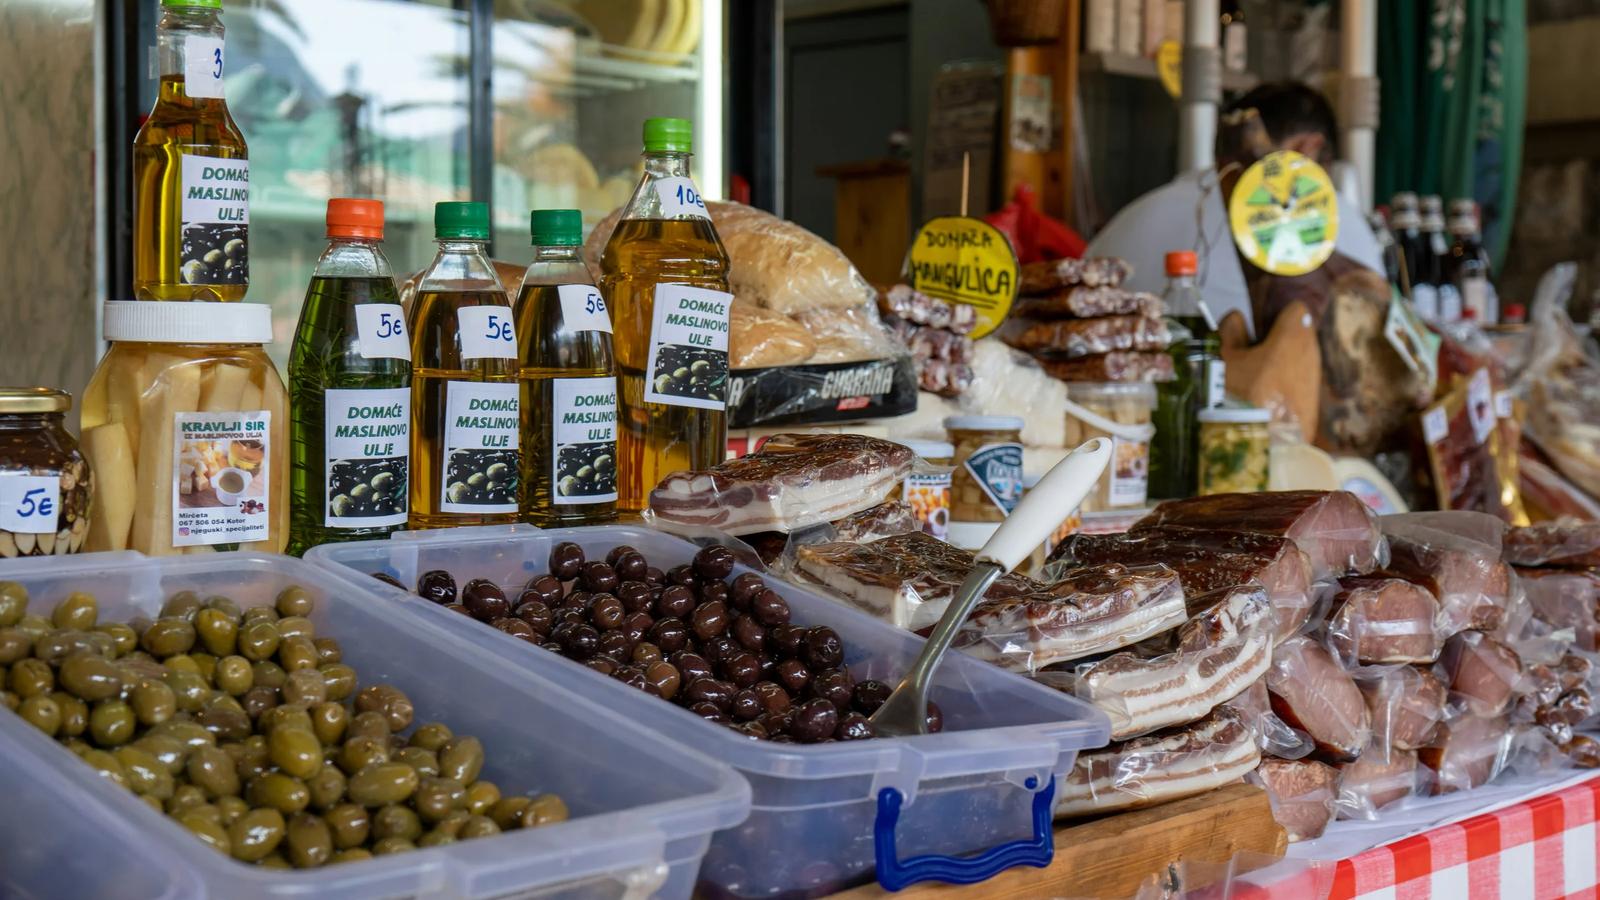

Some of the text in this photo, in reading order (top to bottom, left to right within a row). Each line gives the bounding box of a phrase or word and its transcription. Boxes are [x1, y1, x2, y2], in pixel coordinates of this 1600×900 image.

[217, 207, 245, 221] ULJE
[585, 293, 605, 315] 5€
[376, 313, 402, 338] 5€
[485, 315, 513, 342] 5€
[665, 313, 728, 333] MASLINOVO
[688, 332, 714, 347] ULJE
[821, 366, 894, 399] GUARANA
[181, 421, 265, 432] KRAVLJI SIR
[335, 423, 407, 438] MASLINOVO
[455, 416, 520, 430] MASLINOV
[482, 435, 509, 447] ULJE
[588, 428, 611, 440] ULJE
[364, 443, 394, 457] ULJE
[16, 487, 53, 518] 5€
